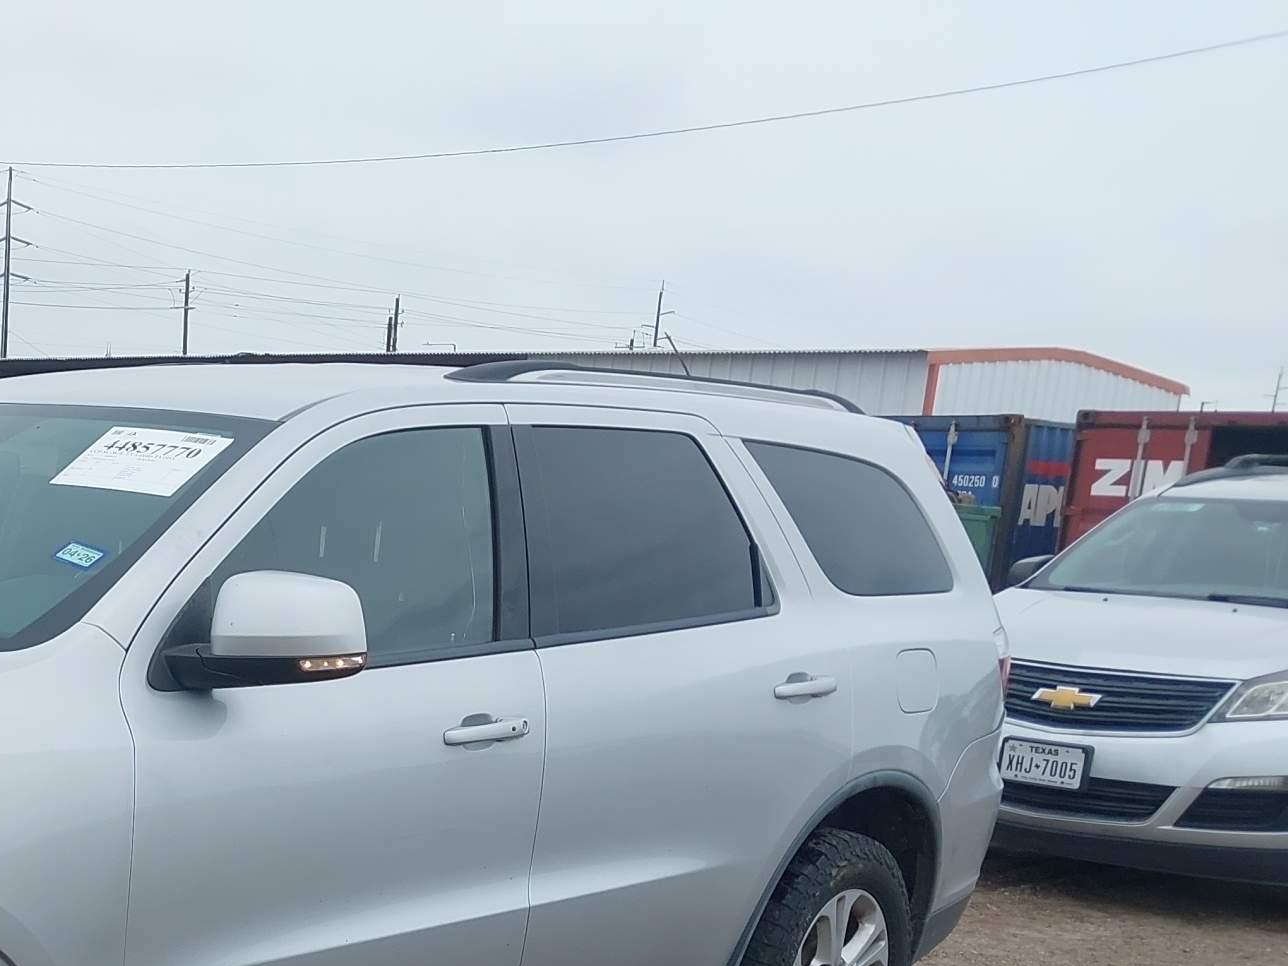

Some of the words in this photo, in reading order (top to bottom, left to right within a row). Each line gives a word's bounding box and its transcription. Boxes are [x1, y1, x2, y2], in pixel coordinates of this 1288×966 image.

[103, 439, 203, 459] 44857770
[1090, 458, 1185, 497] ZIM
[1028, 745, 1060, 757] TEXAS
